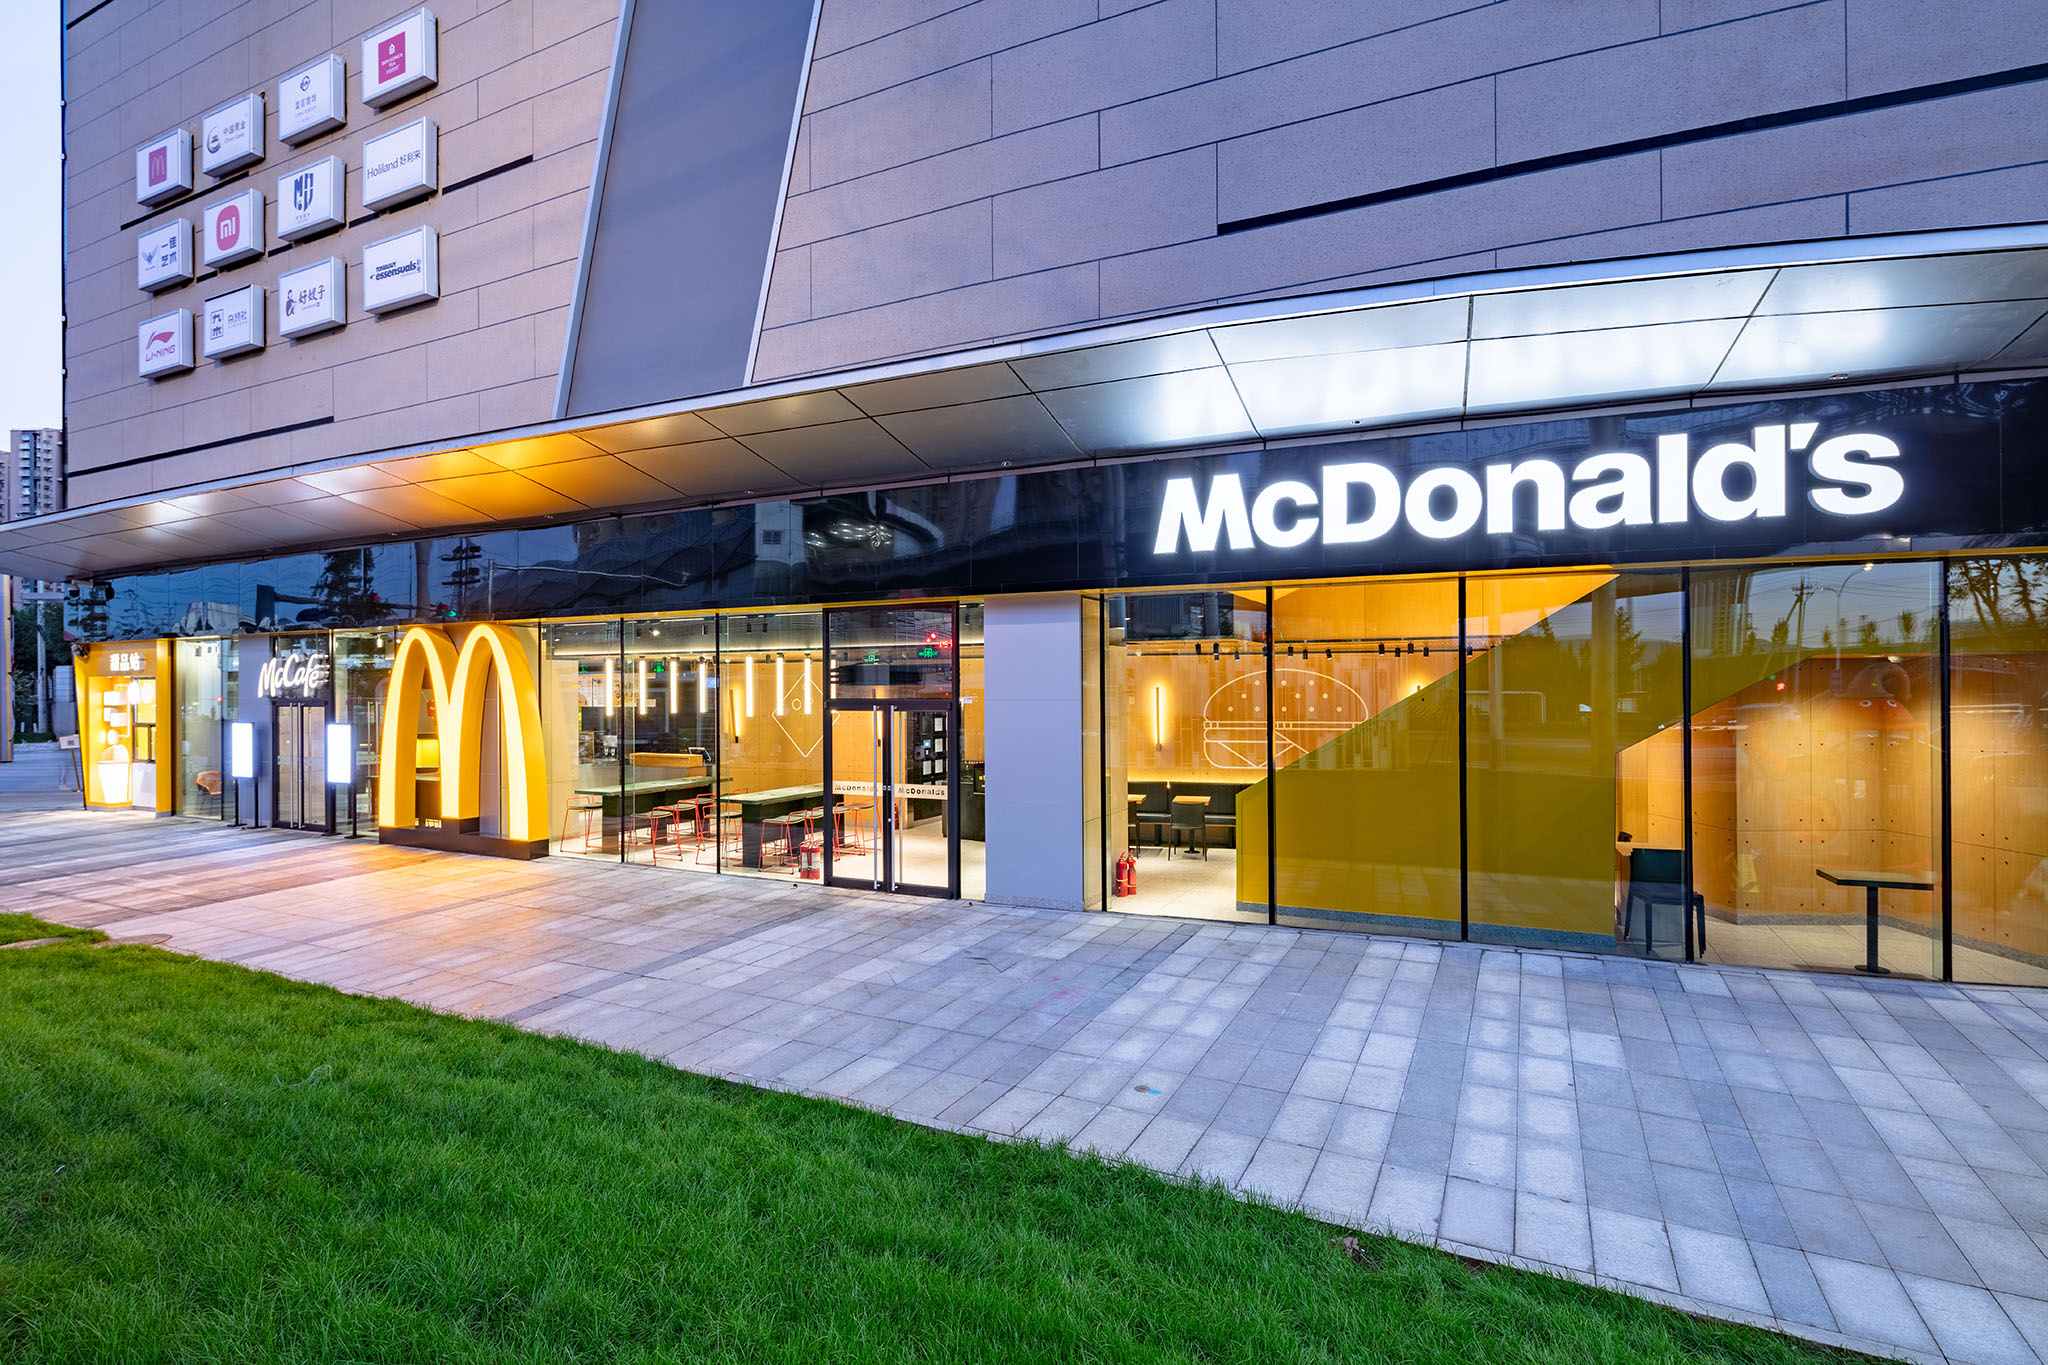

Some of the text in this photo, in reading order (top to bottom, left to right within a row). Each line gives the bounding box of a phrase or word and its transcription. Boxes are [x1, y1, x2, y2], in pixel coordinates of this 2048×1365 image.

[223, 120, 247, 135] 中国黄金
[375, 260, 417, 281] essensuals
[1153, 422, 1905, 555] McDonald's
[257, 653, 322, 698] McCafé
